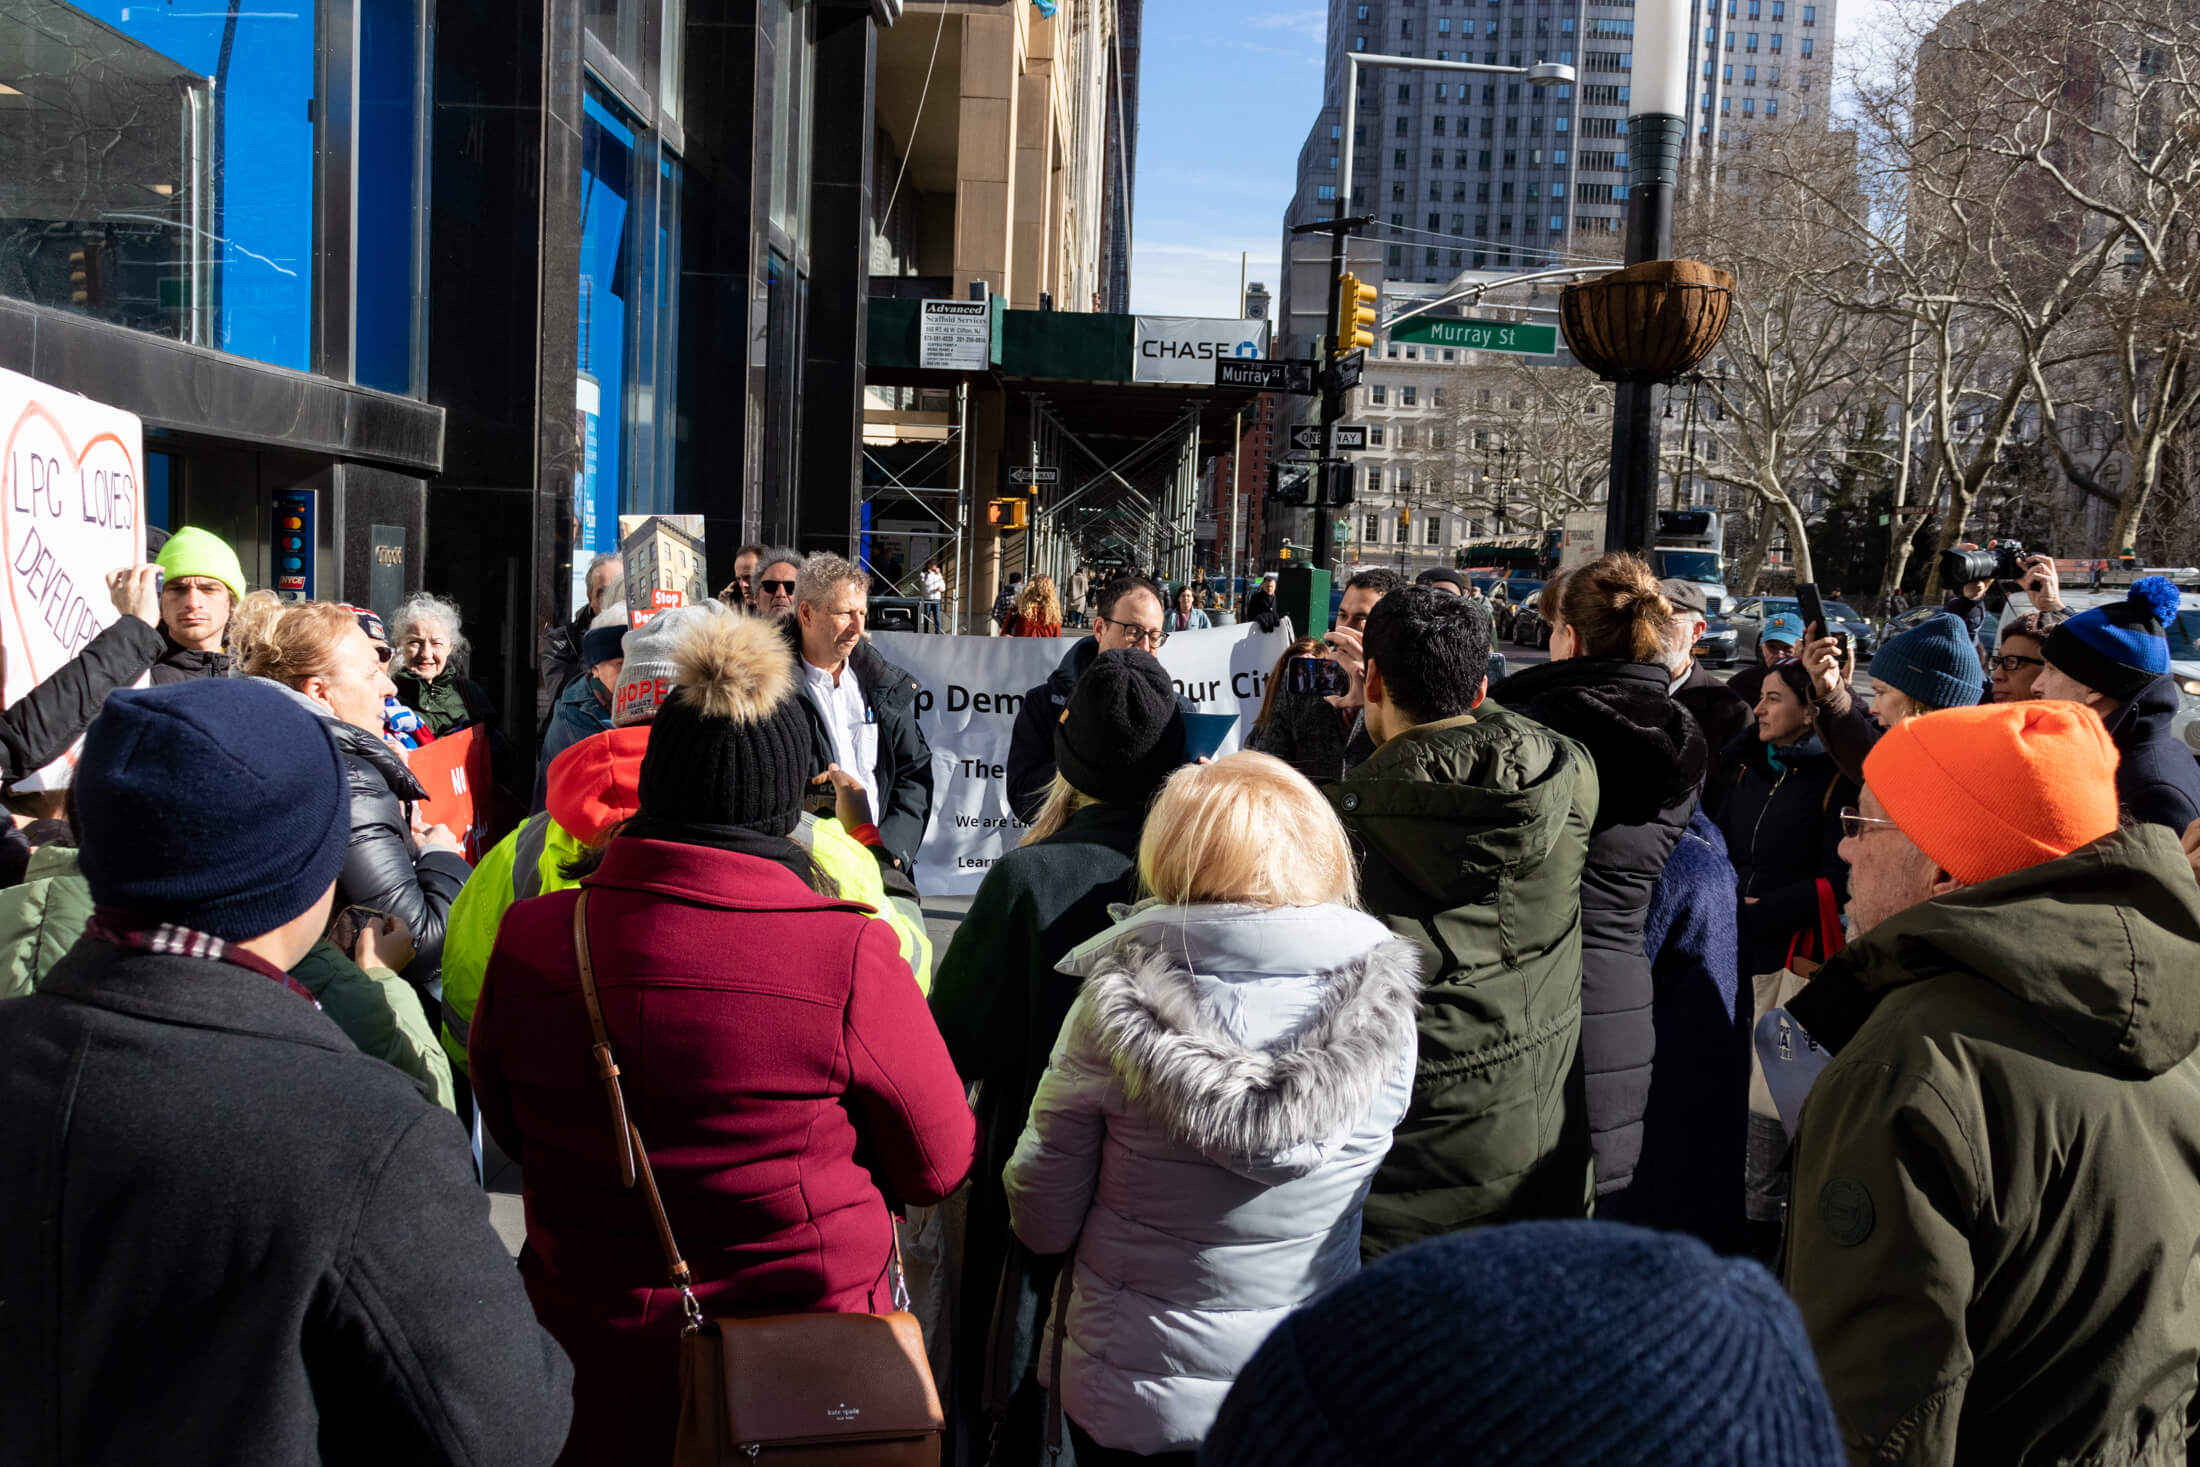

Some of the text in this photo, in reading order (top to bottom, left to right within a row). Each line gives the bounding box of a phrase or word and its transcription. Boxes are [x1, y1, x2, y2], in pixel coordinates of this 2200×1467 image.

[927, 304, 983, 314] Advanced
[957, 316, 987, 325] Services
[1431, 323, 1515, 348] Murray St
[1142, 340, 1230, 360] CHASE
[1222, 365, 1271, 387] Murray
[1301, 433, 1321, 444] ONE
[13, 451, 133, 530] LPC LOVES
[280, 576, 304, 585] NYCE
[655, 591, 679, 607] Stop
[616, 679, 669, 713] HOPE
[961, 759, 1004, 779] The
[956, 815, 979, 828] We
[983, 817, 1008, 828] are
